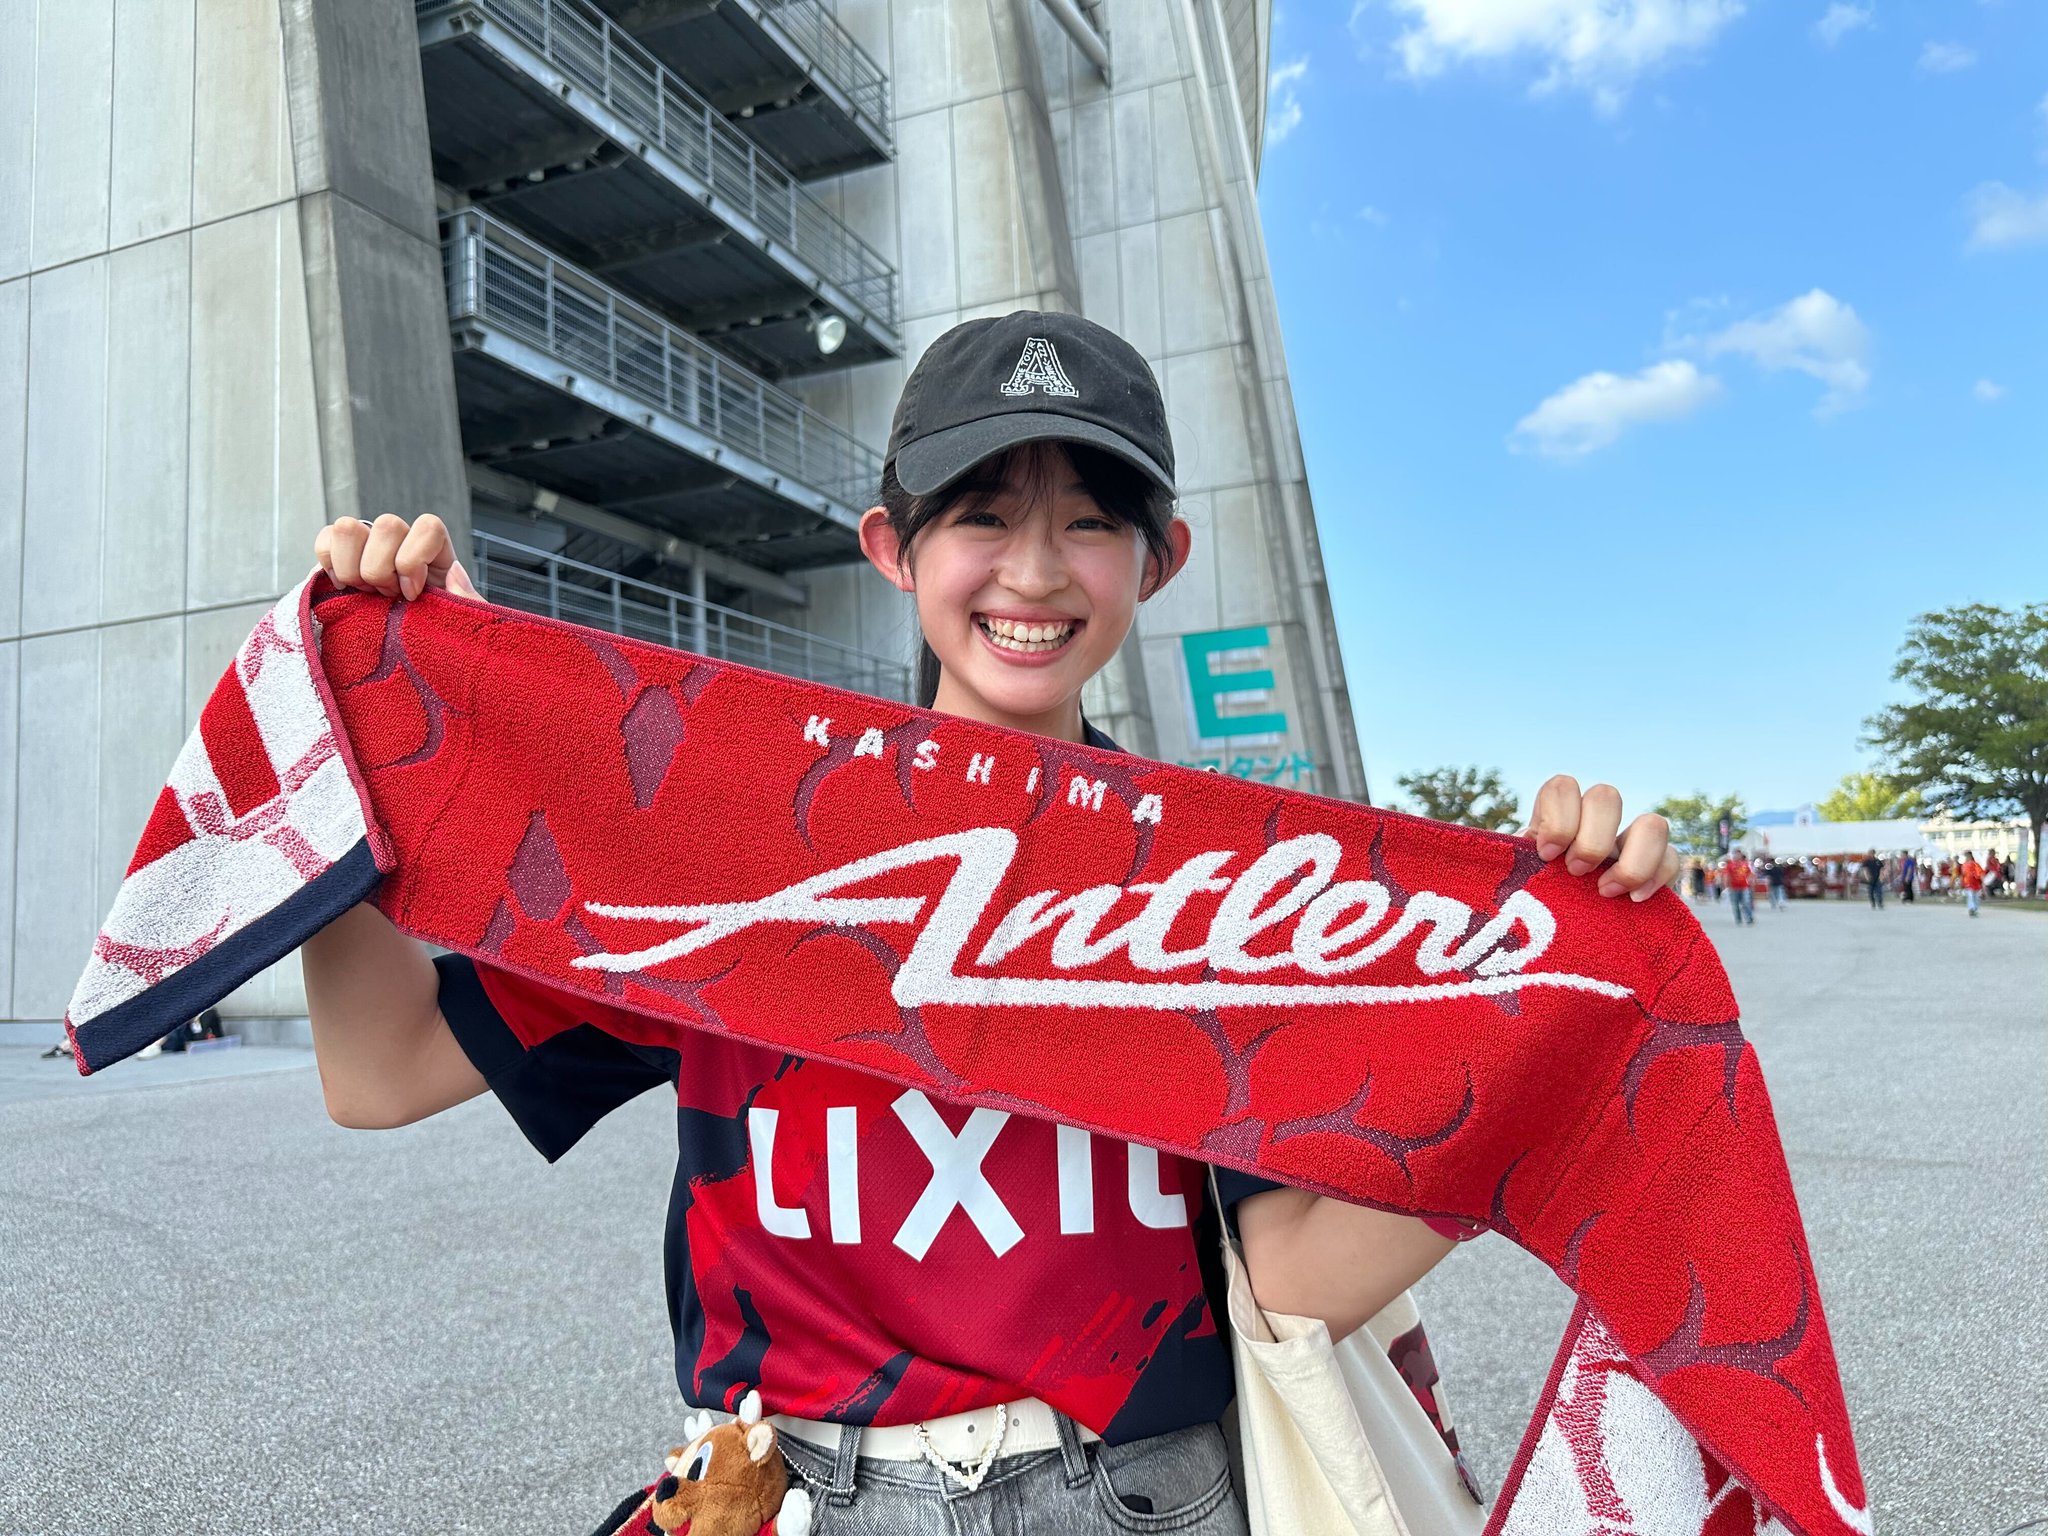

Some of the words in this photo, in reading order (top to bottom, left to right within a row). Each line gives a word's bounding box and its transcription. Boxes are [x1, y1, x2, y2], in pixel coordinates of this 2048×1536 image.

[1182, 626, 1289, 739] E
[803, 714, 1164, 826] KASHIMA
[571, 825, 1635, 1012] Antlers
[748, 1087, 1188, 1263] LIXIL
